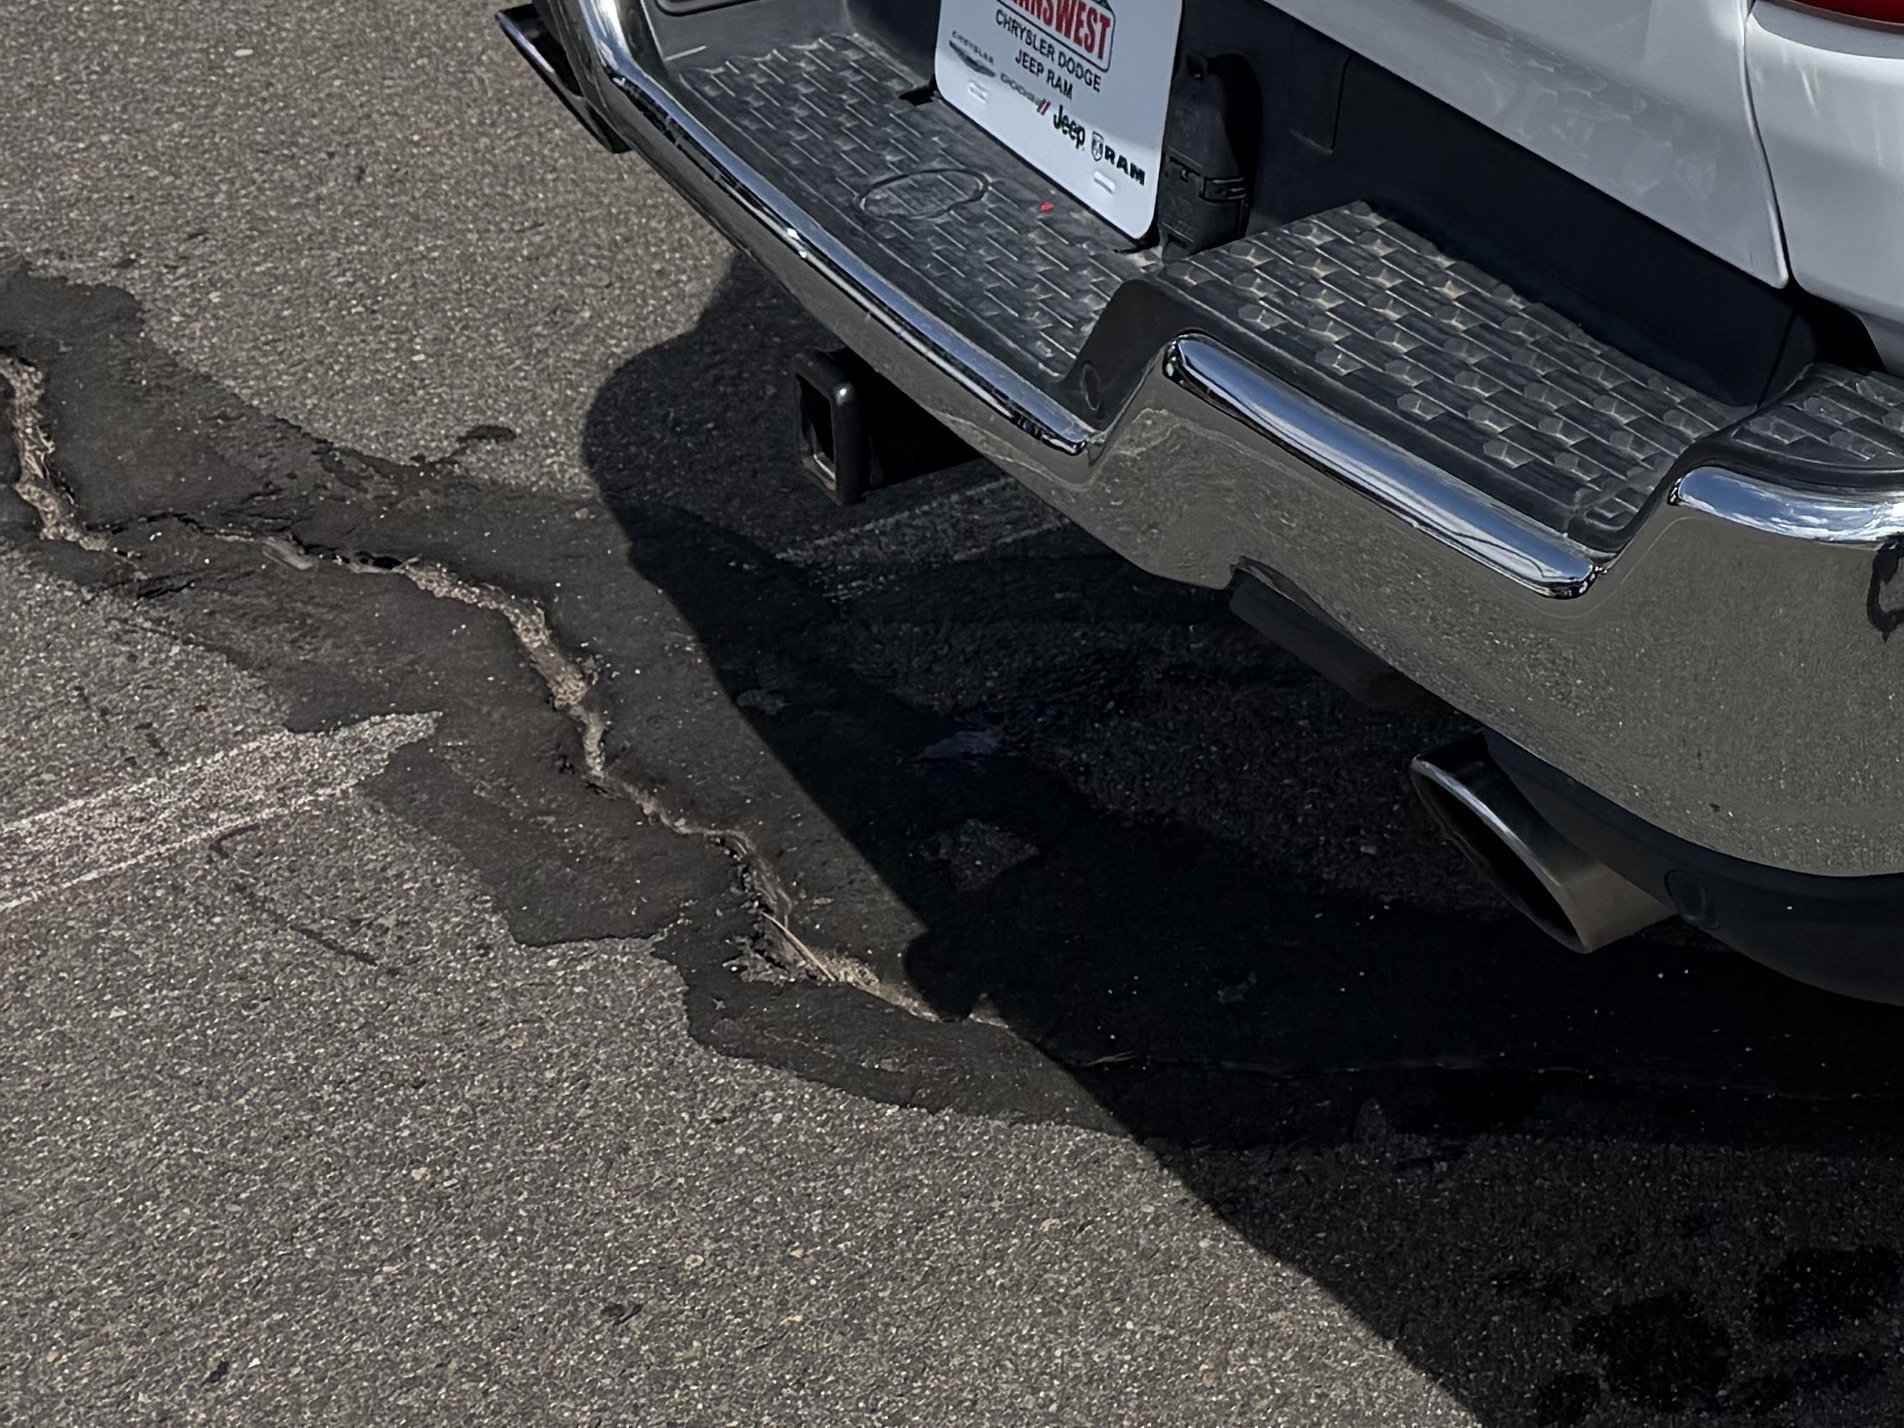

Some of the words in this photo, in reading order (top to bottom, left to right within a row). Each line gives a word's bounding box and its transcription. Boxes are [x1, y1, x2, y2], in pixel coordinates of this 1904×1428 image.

[995, 8, 1055, 63] CHRYSLER
[1057, 51, 1102, 93] DODGE
[1014, 48, 1045, 78] JEEP
[1046, 68, 1074, 101] RAM
[1053, 104, 1087, 150] Jeep
[1104, 144, 1146, 186] RAM
